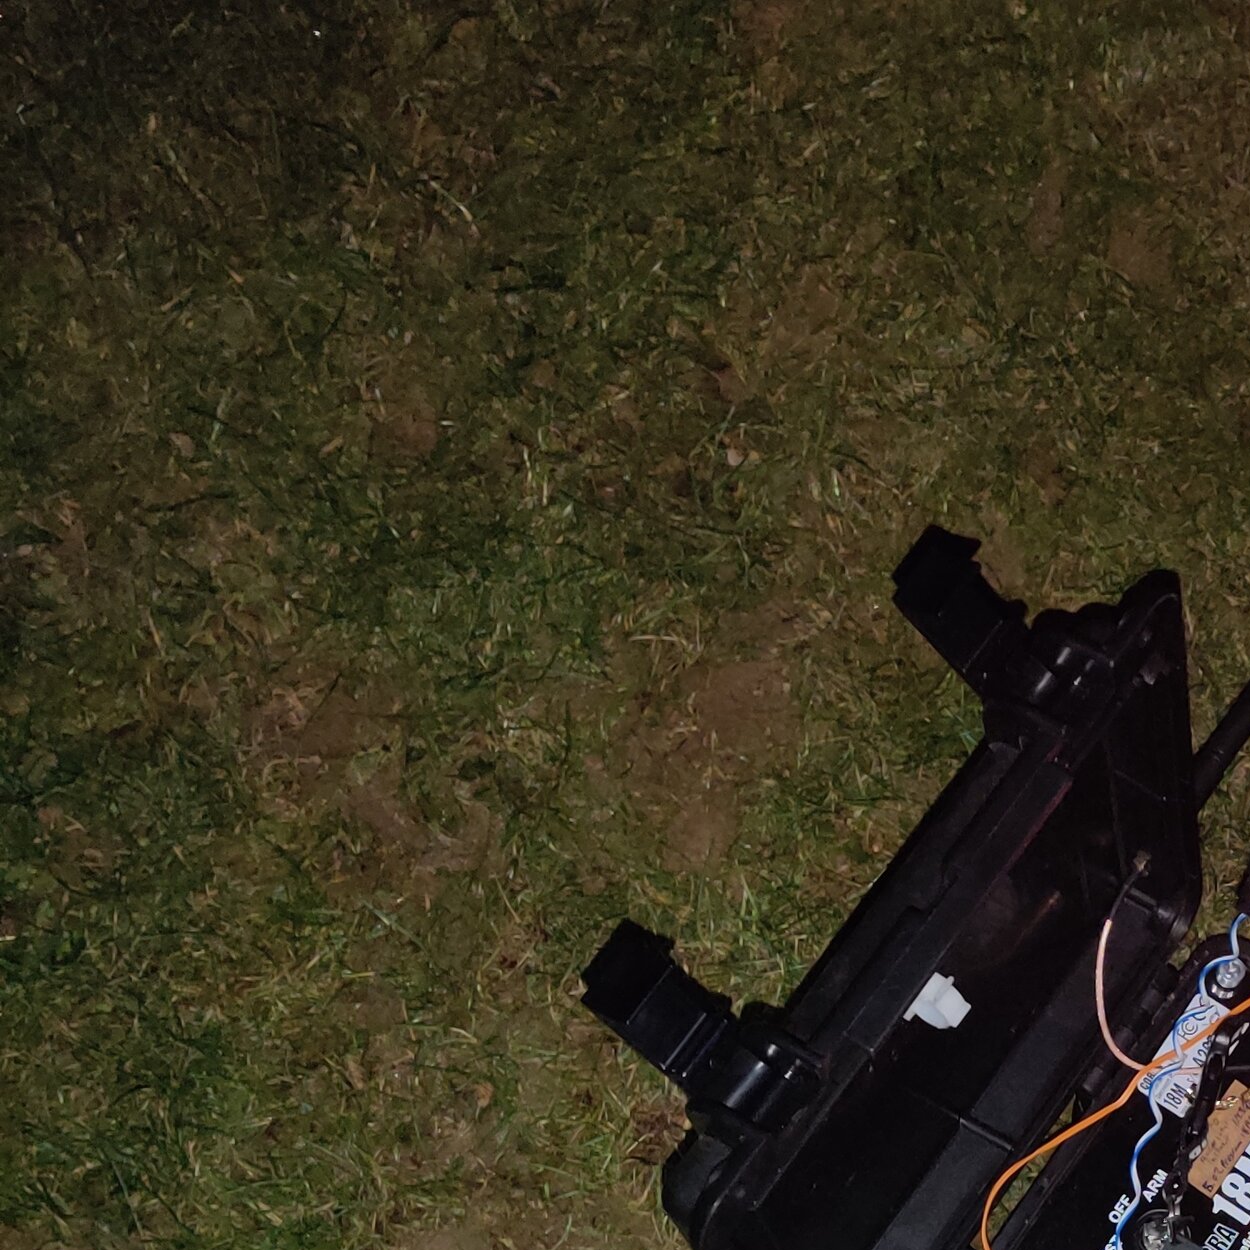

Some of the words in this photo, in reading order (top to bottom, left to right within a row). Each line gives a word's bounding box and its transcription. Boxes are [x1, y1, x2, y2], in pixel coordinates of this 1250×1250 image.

[1162, 1081, 1189, 1110] 18M
[1142, 1168, 1169, 1203] ARM
[1108, 1193, 1136, 1227] OFF
